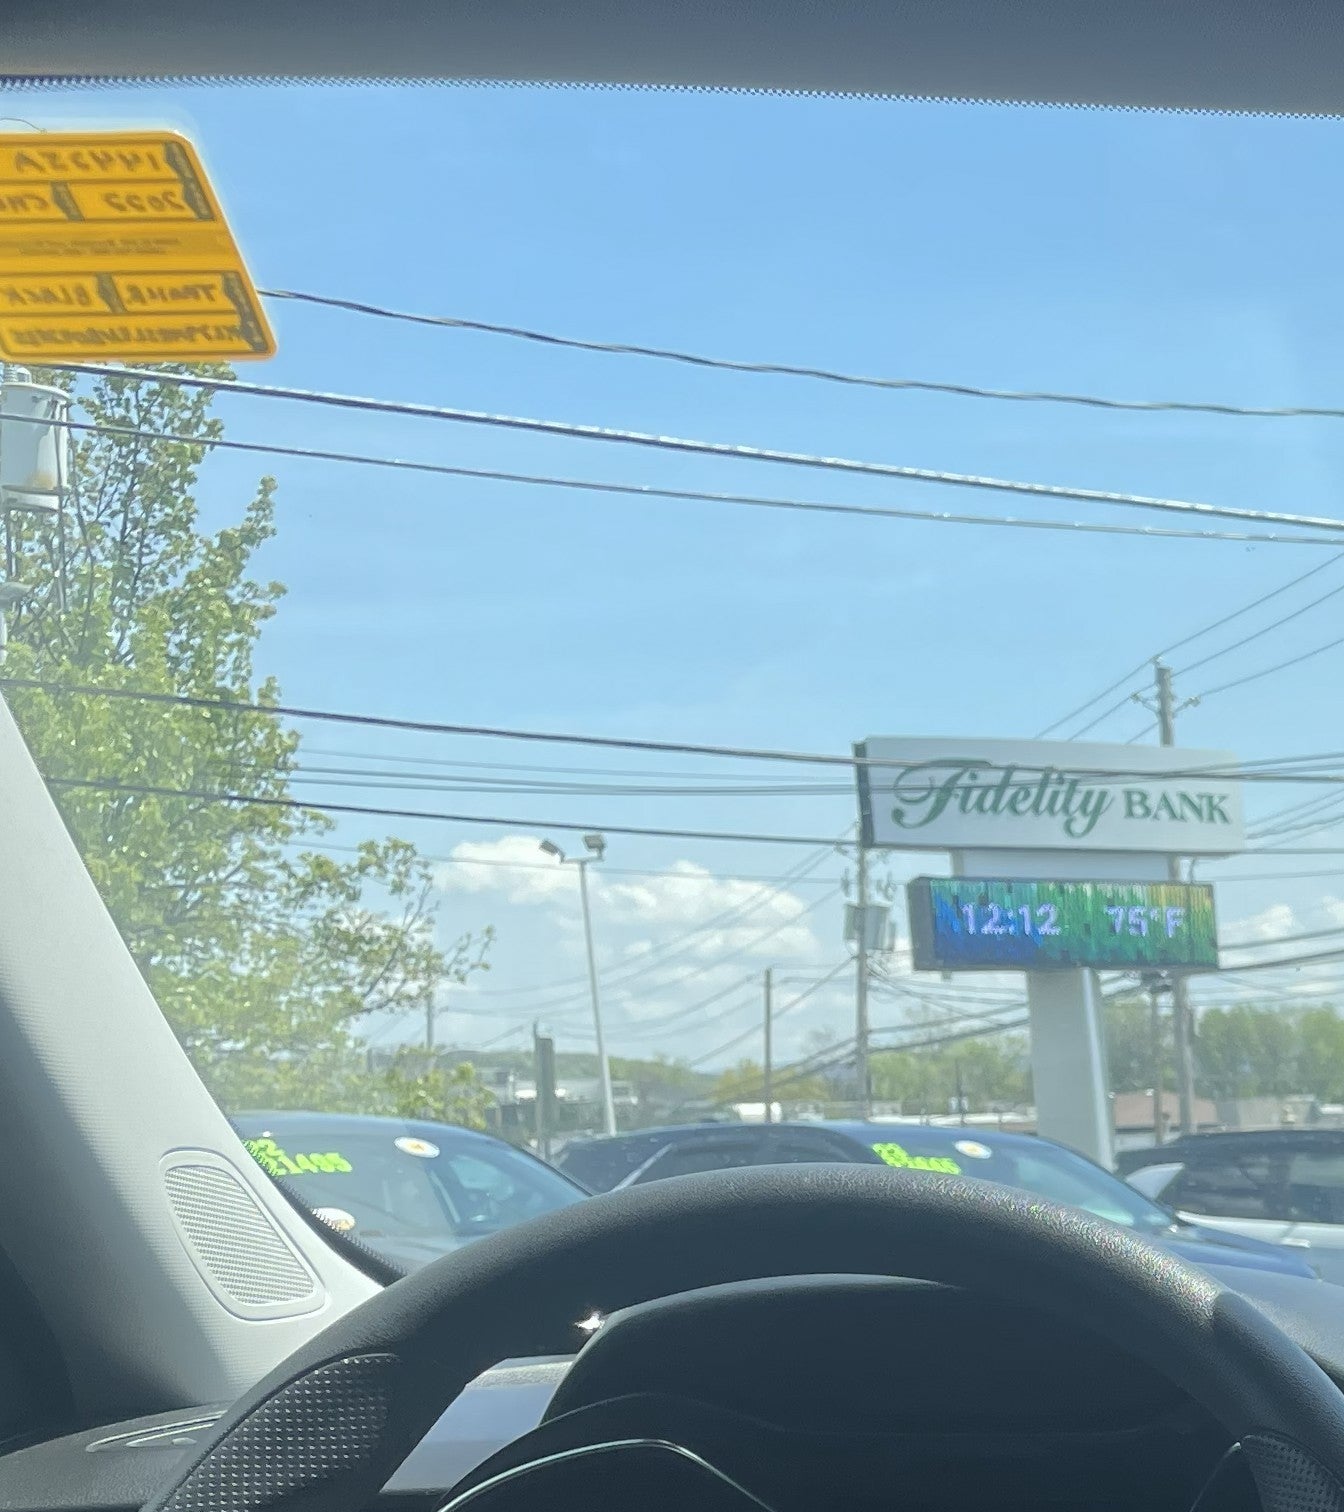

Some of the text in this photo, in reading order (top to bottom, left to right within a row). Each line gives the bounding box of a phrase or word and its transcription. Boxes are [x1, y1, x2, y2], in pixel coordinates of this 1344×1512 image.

[890, 756, 1231, 839] Fidelity BANK
[960, 903, 1062, 937] 12:12
